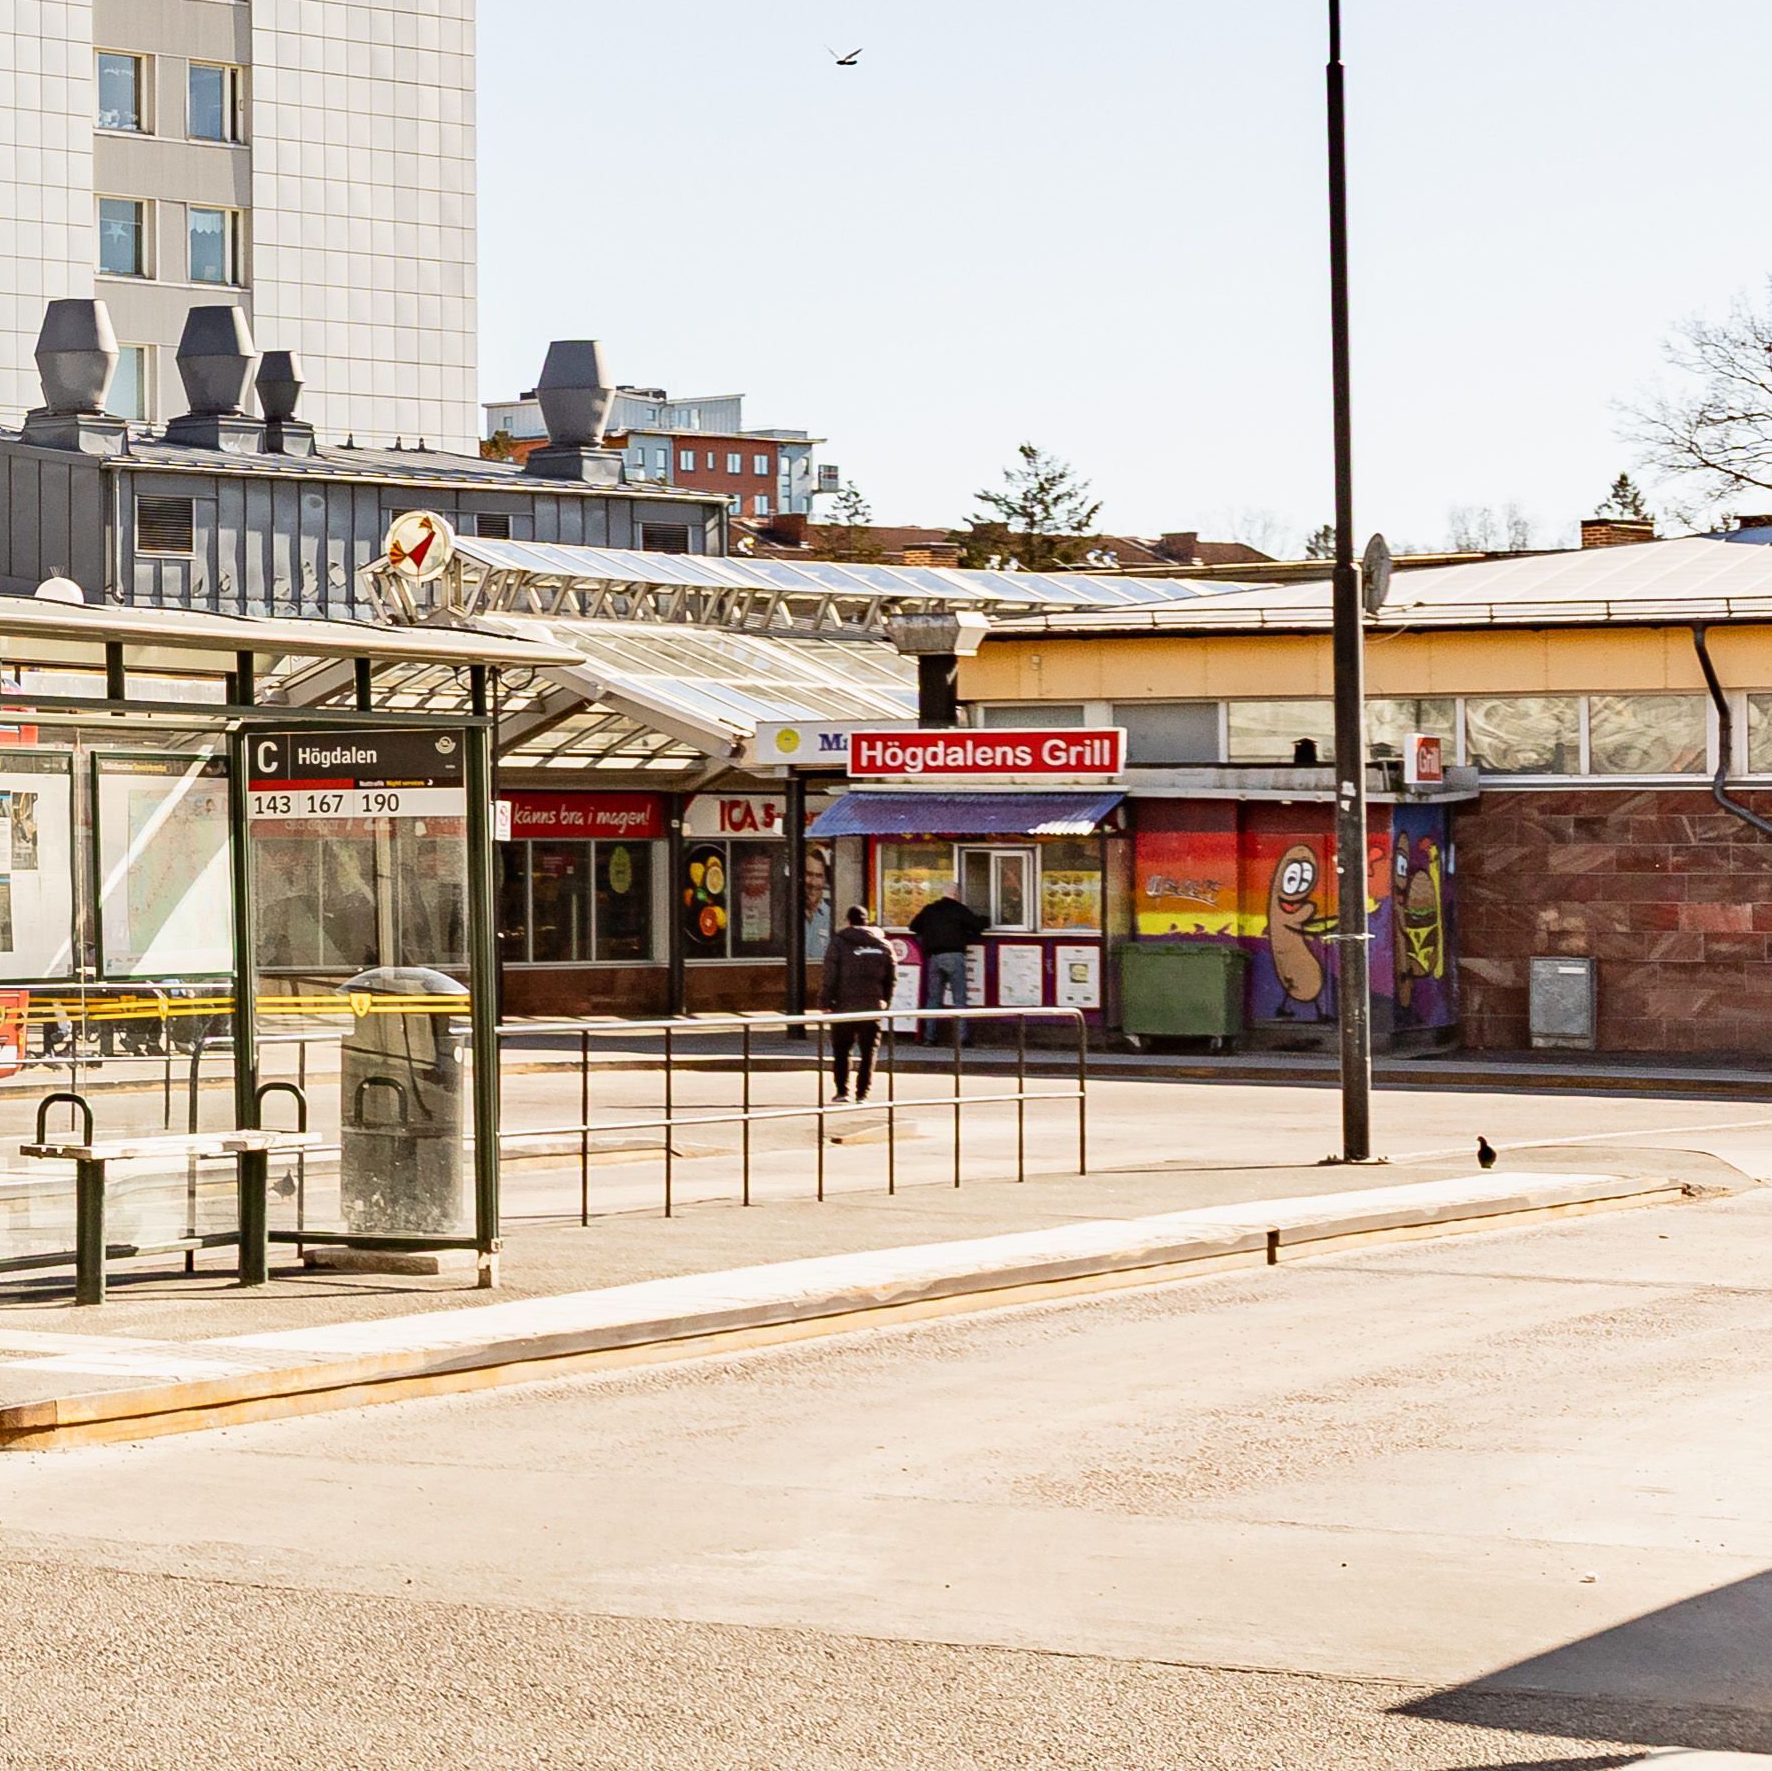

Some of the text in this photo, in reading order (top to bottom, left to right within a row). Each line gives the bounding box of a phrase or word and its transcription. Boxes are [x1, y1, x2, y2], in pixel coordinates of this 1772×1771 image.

[257, 740, 279, 774] C
[298, 746, 378, 768] Högdalen
[859, 739, 1033, 773] Högdalens
[1040, 738, 1111, 767] Grill
[254, 793, 400, 814] 143 167 190
[513, 803, 652, 834] känns bra i magen!
[719, 799, 759, 832] ICA
